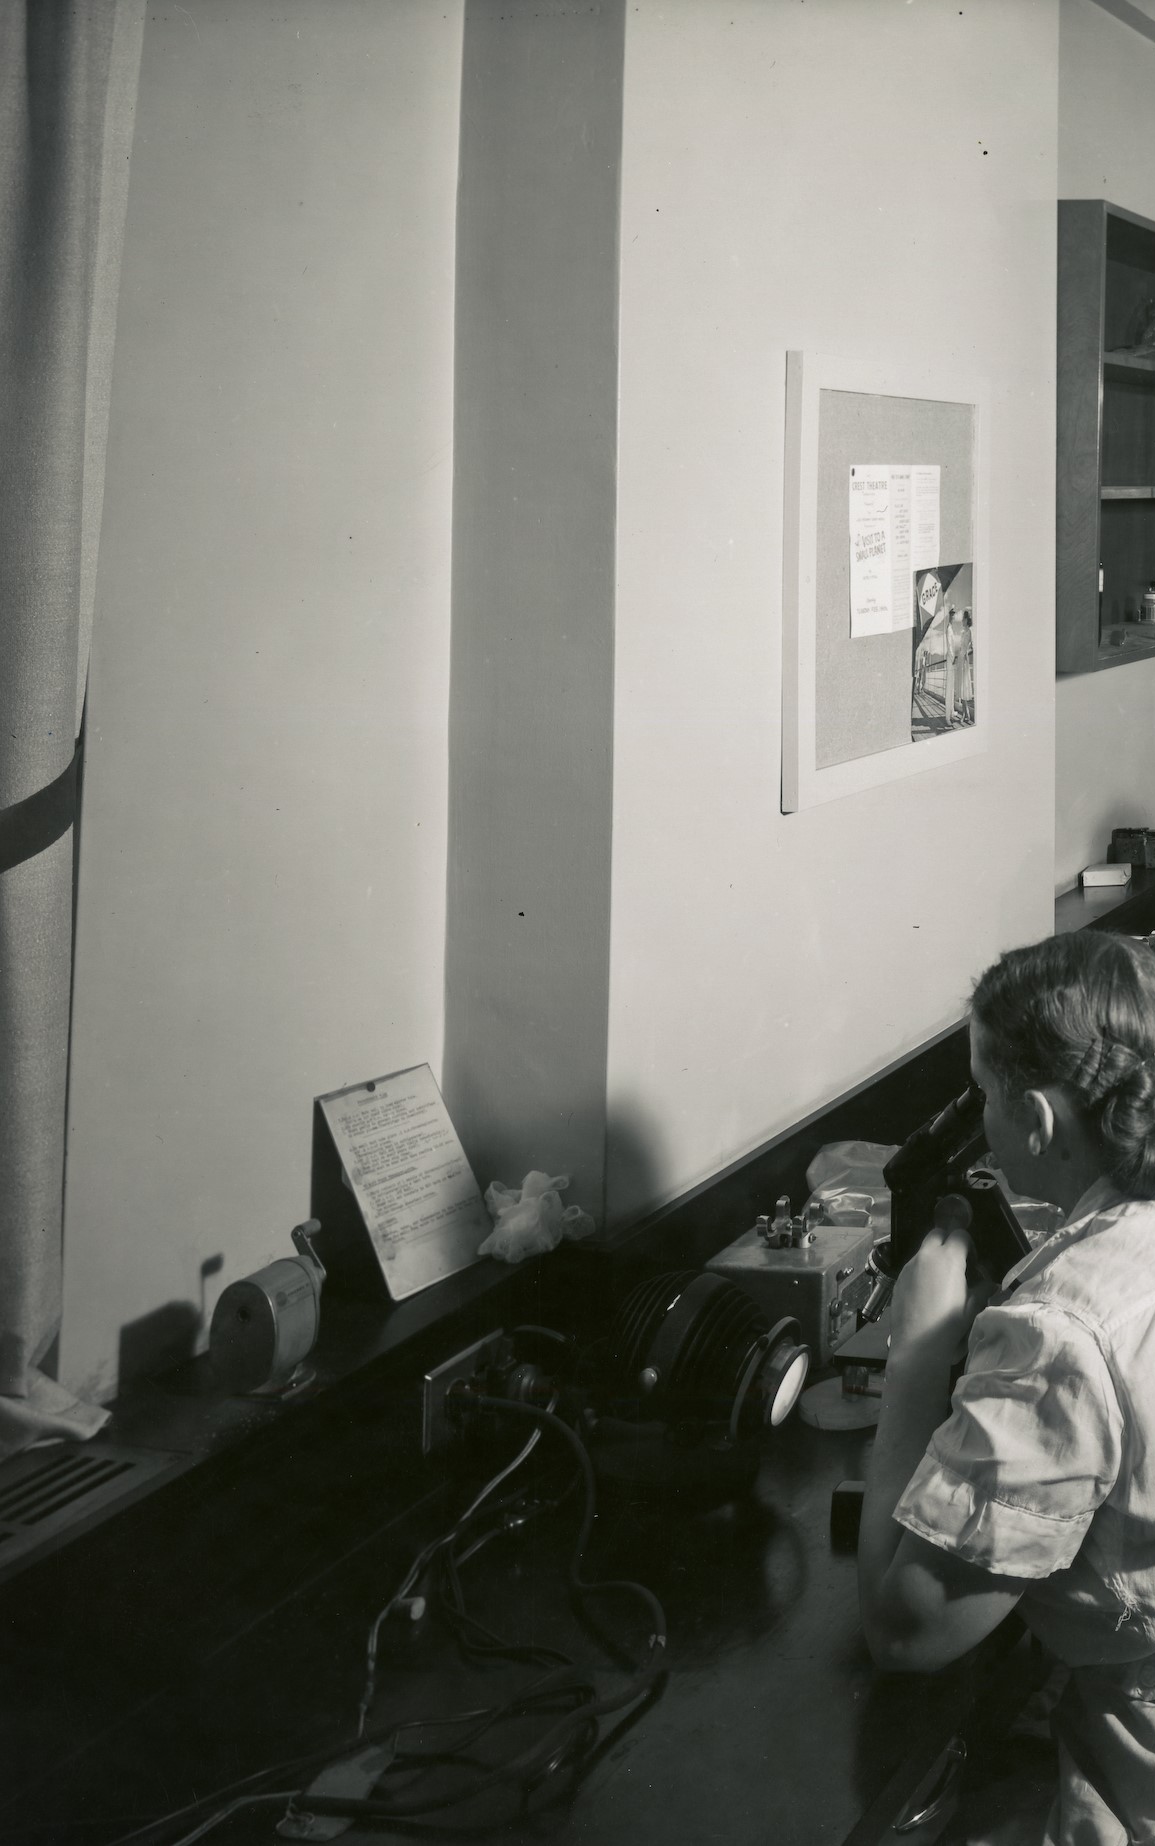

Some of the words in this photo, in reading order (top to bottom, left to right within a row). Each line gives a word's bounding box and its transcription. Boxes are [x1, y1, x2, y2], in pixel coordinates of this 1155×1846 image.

[852, 481, 865, 491] CREST
[867, 481, 888, 490] THEATRE
[868, 543, 886, 557] PLANET
[921, 582, 938, 605] GRACE
